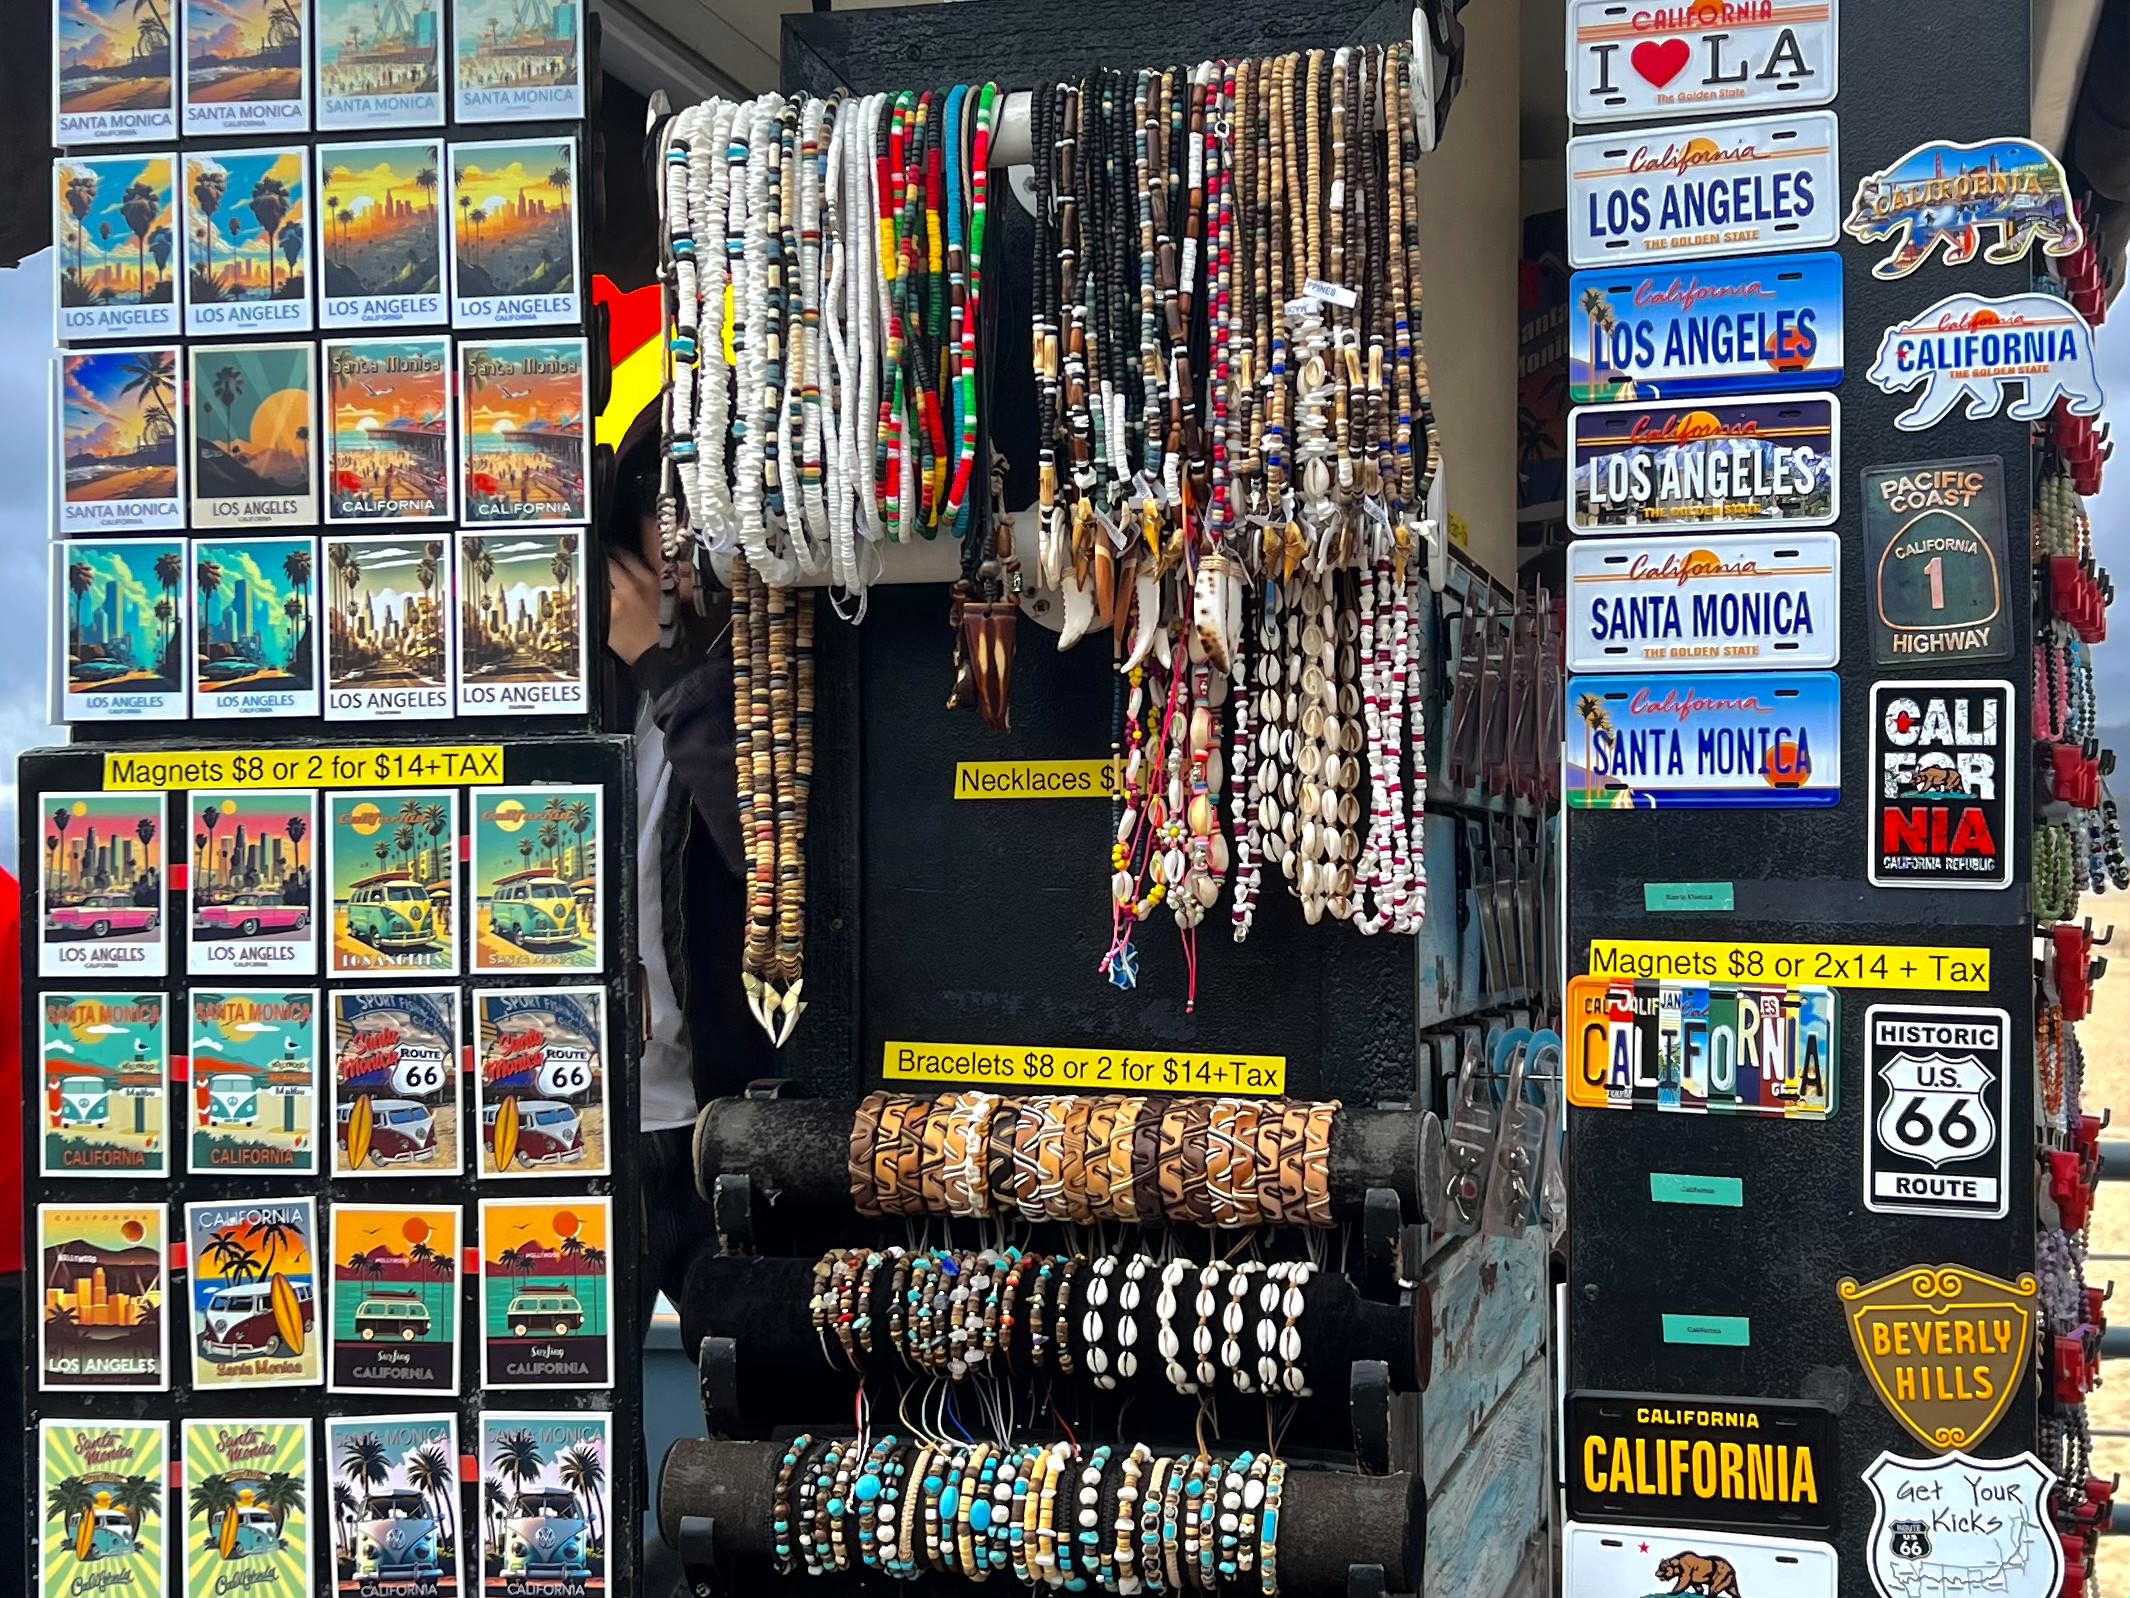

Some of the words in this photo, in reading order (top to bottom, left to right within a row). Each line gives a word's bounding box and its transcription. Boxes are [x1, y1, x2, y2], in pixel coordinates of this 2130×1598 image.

[1631, 1, 1772, 31] CALIFORNIA
[1590, 44, 1619, 95] I
[1702, 28, 1815, 84] LA
[326, 100, 371, 113] SANTA
[375, 96, 434, 111] MONICA
[464, 92, 510, 105] SANTA
[514, 89, 573, 103] MONICA
[1657, 94, 1674, 104] The
[1678, 90, 1717, 102] Golden
[1719, 88, 1745, 98] State
[61, 116, 107, 130] SANTA
[110, 113, 171, 128] MONICA
[188, 107, 236, 120] SANTA
[240, 105, 302, 118] MONICA
[1628, 139, 1771, 176] California
[1590, 187, 1650, 237] LOS
[1660, 170, 1814, 230] ANGELES
[1873, 173, 2042, 216] CALIFORNIA
[1644, 239, 1667, 250] THE
[1672, 234, 1720, 248] GOLDEN
[1724, 230, 1759, 242] STATE
[1633, 276, 1776, 313] California
[195, 308, 224, 323] LOS
[228, 304, 299, 321] ANGELES
[329, 301, 359, 315] LOS
[364, 298, 437, 314] ANGELES
[461, 301, 491, 316] LOS
[497, 298, 571, 314] ANGELES
[66, 312, 94, 326] LOS
[98, 309, 169, 325] ANGELES
[1937, 311, 2034, 333] California
[1594, 320, 1655, 370] LOS
[1663, 308, 1817, 367] ANGELES
[1897, 328, 2078, 372] CALIFORNIA
[333, 358, 378, 374] Santa
[385, 356, 441, 372] Monica
[468, 359, 514, 376] Santa
[522, 357, 577, 375] Monica
[1950, 370, 1969, 378] THE
[1972, 367, 2015, 378] GOLDEN
[2018, 365, 2049, 374] STATE
[1630, 413, 1765, 448] California
[1589, 454, 1651, 503] LOS
[1660, 446, 1817, 500] ANGELES
[1880, 471, 1984, 499] PACIFIC
[66, 506, 113, 519] SANTA
[117, 503, 178, 516] MONICA
[213, 502, 239, 516] LOS
[244, 501, 297, 515] ANGELES
[342, 500, 435, 512] CALIFORNIA
[478, 502, 572, 515] CALIFORNIA
[1643, 507, 1667, 518] THE
[1671, 505, 1721, 517] GOLDEN
[1725, 503, 1761, 515] STATE
[1890, 490, 1977, 513] COAST
[1895, 538, 1978, 559] CALIFORNIA
[1629, 553, 1772, 587] California
[1924, 557, 1944, 610] 1
[1591, 595, 1682, 640] SANTA
[1693, 591, 1814, 637] MONICA
[1892, 627, 1991, 654] HIGHWAY
[1643, 648, 1666, 658] THE
[1671, 647, 1719, 658] GOLDEN
[1723, 645, 1759, 656] STATE
[87, 697, 109, 708] LOS
[113, 696, 163, 707] ANGELES
[217, 697, 239, 708] LOS
[243, 695, 294, 706] ANGELES
[330, 694, 362, 709] LOS
[367, 692, 447, 708] ANGELES
[463, 687, 495, 703] LOS
[500, 686, 581, 702] ANGELES
[1630, 688, 1775, 722] California
[1885, 697, 1998, 746] CALI
[1593, 728, 1684, 776] SANTA
[1698, 726, 1812, 776] MONICA
[112, 760, 222, 785] Magnets
[232, 756, 264, 782] $8
[273, 761, 296, 781] or
[308, 756, 322, 780] 2
[332, 755, 366, 779] for
[375, 752, 498, 779] $14+TAX
[1884, 751, 1995, 800] FOR
[962, 768, 1090, 792] Necklaces
[1883, 806, 1996, 855] NIA
[1883, 857, 1941, 870] CALIFORNIA
[1945, 858, 1995, 871] REPUBLIC
[59, 949, 86, 961] LOS
[91, 948, 145, 961] ANGELES
[208, 947, 236, 961] LOS
[239, 947, 295, 960] ANGELES
[1593, 947, 1716, 977] Magnets
[1728, 948, 1764, 978] $8
[1775, 956, 1805, 977] or
[1814, 951, 1888, 979] 2x14
[1900, 960, 1917, 977] +
[1929, 956, 1986, 983] Tax
[47, 1006, 96, 1023] SANTA
[100, 1005, 159, 1023] MONICA
[195, 1004, 243, 1021] SANTA
[249, 1003, 311, 1021] MONICA
[1881, 1025, 1995, 1046] HISTORIC
[400, 1048, 441, 1060] ROUTE
[546, 1049, 587, 1060] ROUTE
[1583, 998, 1824, 1098] CALIFORNIA
[406, 1066, 437, 1087] 66
[552, 1067, 584, 1088] 66
[899, 1049, 1014, 1077] Bracelets
[1024, 1052, 1054, 1078] $8
[1063, 1061, 1089, 1079] or
[1097, 1058, 1113, 1080] 2
[1121, 1057, 1155, 1082] for
[1163, 1057, 1278, 1087] $14+Tax
[1917, 1066, 1962, 1088] U.S.
[1895, 1096, 1977, 1148] 66
[64, 1150, 145, 1166] CALIFORNIA
[210, 1148, 294, 1165] CALIFORNIA
[1896, 1177, 1977, 1197] ROUTE
[199, 1209, 304, 1228] CALIFORNIA
[1872, 1320, 2012, 1356] BEVERLY
[378, 1350, 410, 1364] Surfing
[531, 1345, 564, 1359] Surfing
[49, 1359, 79, 1372] LOS
[86, 1359, 156, 1372] ANGELES
[217, 1363, 251, 1376] Santa
[255, 1360, 303, 1375] Monica
[353, 1367, 434, 1380] CALIFORNIA
[507, 1362, 589, 1375] CALIFORNIA
[1896, 1365, 1993, 1400] HILLS
[1637, 1408, 1759, 1429] CALIFORNIA
[75, 1431, 121, 1454] Santa
[216, 1428, 265, 1453] Santa
[335, 1430, 381, 1447] SANTA
[386, 1426, 449, 1445] MONICA
[488, 1427, 534, 1442] SANTA
[540, 1426, 603, 1442] MONICA
[84, 1445, 133, 1465] Monica
[227, 1442, 277, 1463] Monica
[1583, 1435, 1818, 1504] CALIFORNIA
[1932, 1506, 2003, 1535] Kicks
[1900, 1541, 1922, 1556] 66
[71, 1568, 135, 1597] California
[215, 1566, 279, 1596] California
[360, 1583, 438, 1597] CALIFORNIA
[507, 1582, 585, 1597] CALIFORNIA
